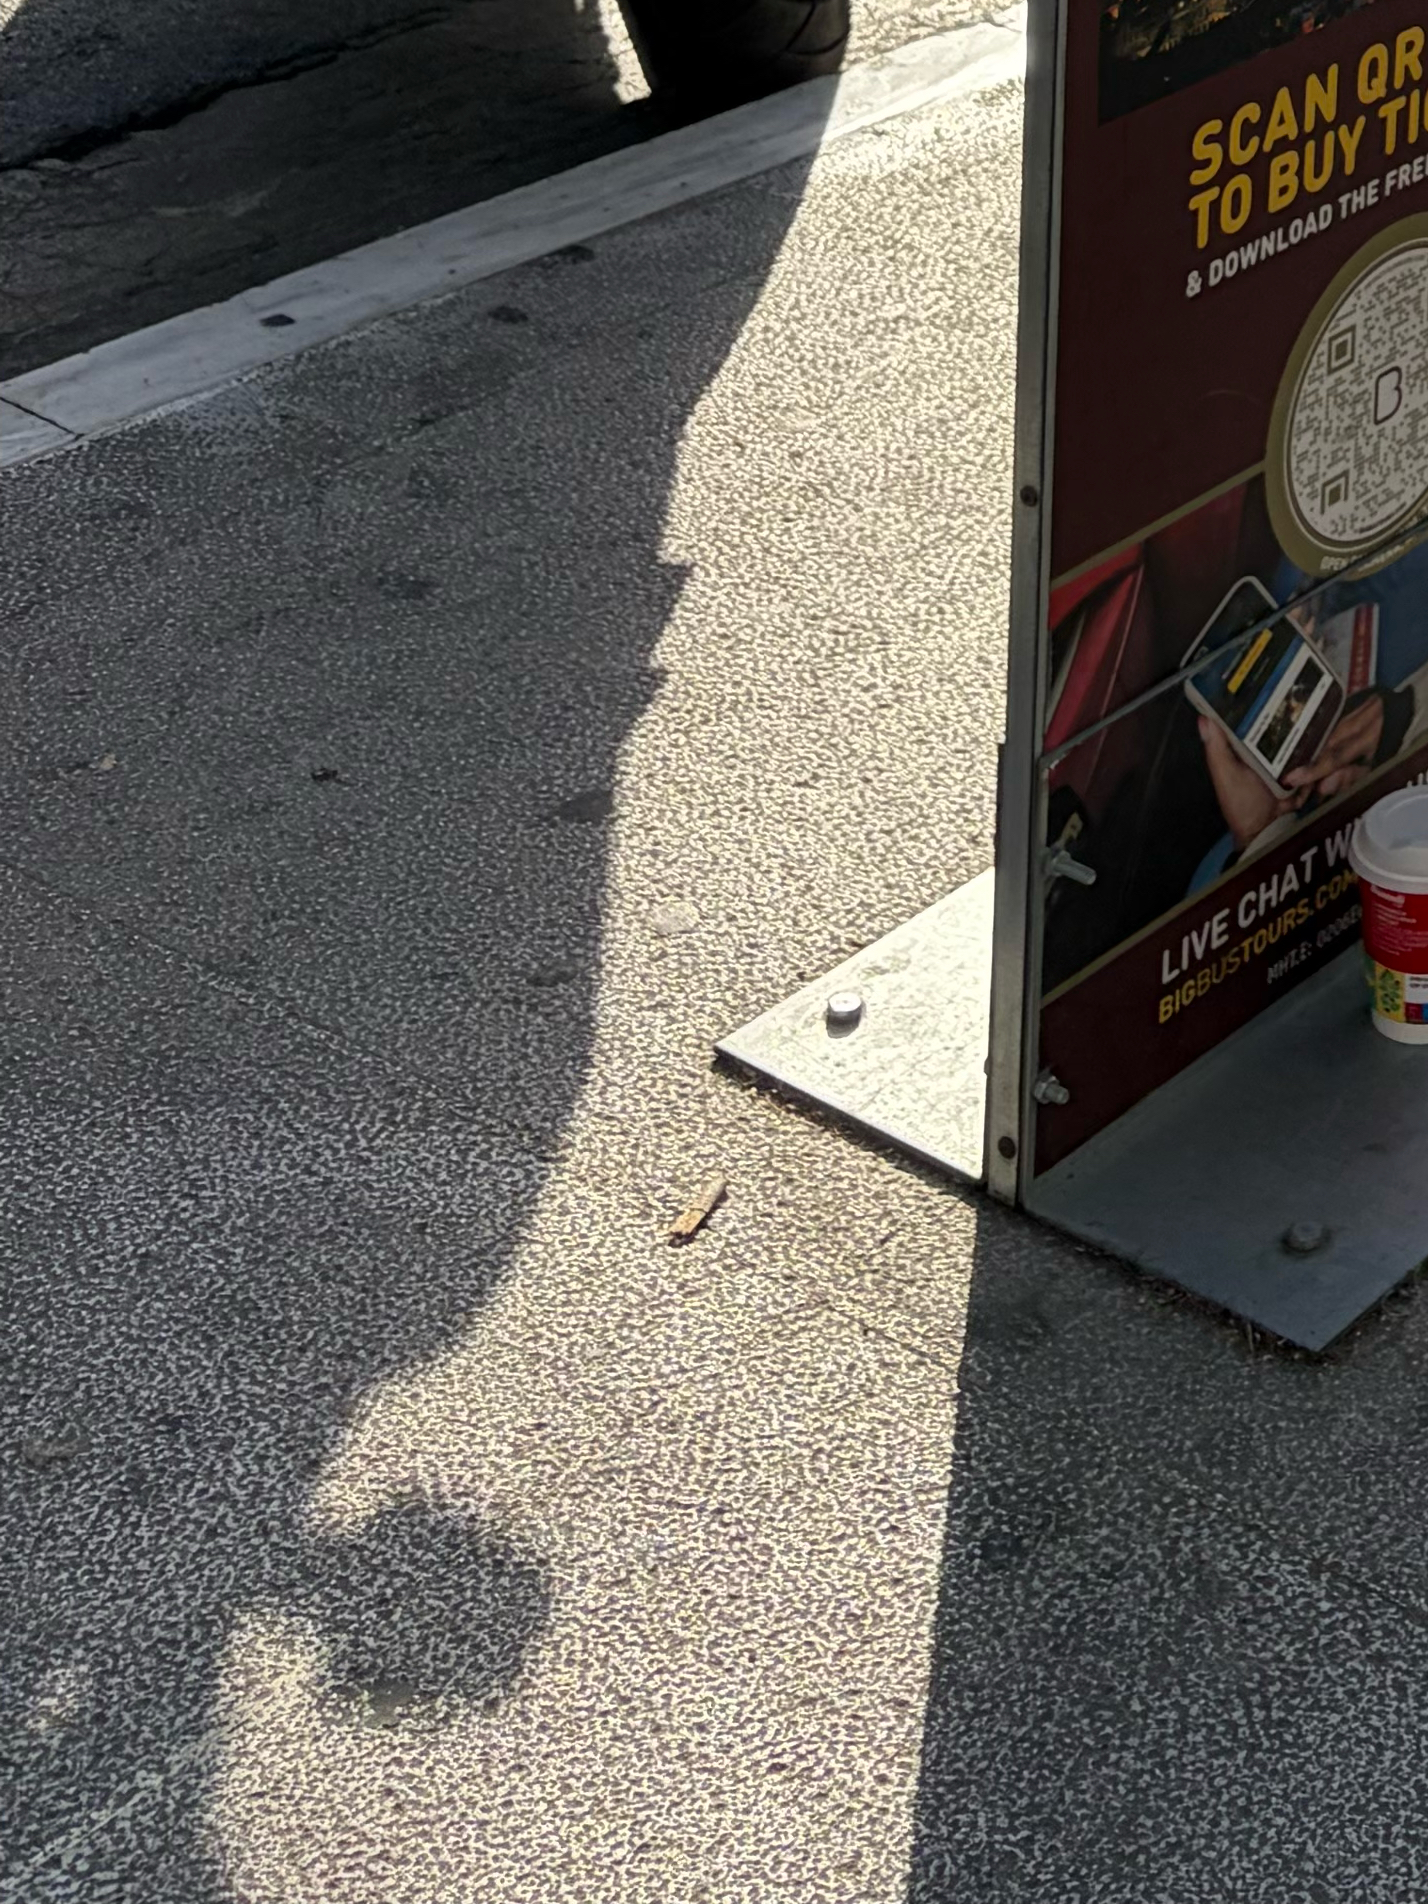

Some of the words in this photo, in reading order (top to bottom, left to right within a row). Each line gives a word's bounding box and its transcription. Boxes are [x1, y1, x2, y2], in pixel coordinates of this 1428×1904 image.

[1190, 63, 1339, 186] SCAN
[1357, 25, 1425, 105] QR
[1185, 270, 1203, 299] &
[1208, 202, 1334, 287] DOWNLOAD
[1338, 178, 1380, 220] THE
[1188, 173, 1253, 249] TO
[1267, 114, 1366, 214] BUY
[1158, 868, 1362, 1025] BIGBUSTOURS.COM
[1161, 907, 1230, 985] LIVE
[1237, 846, 1319, 929] CHAT
